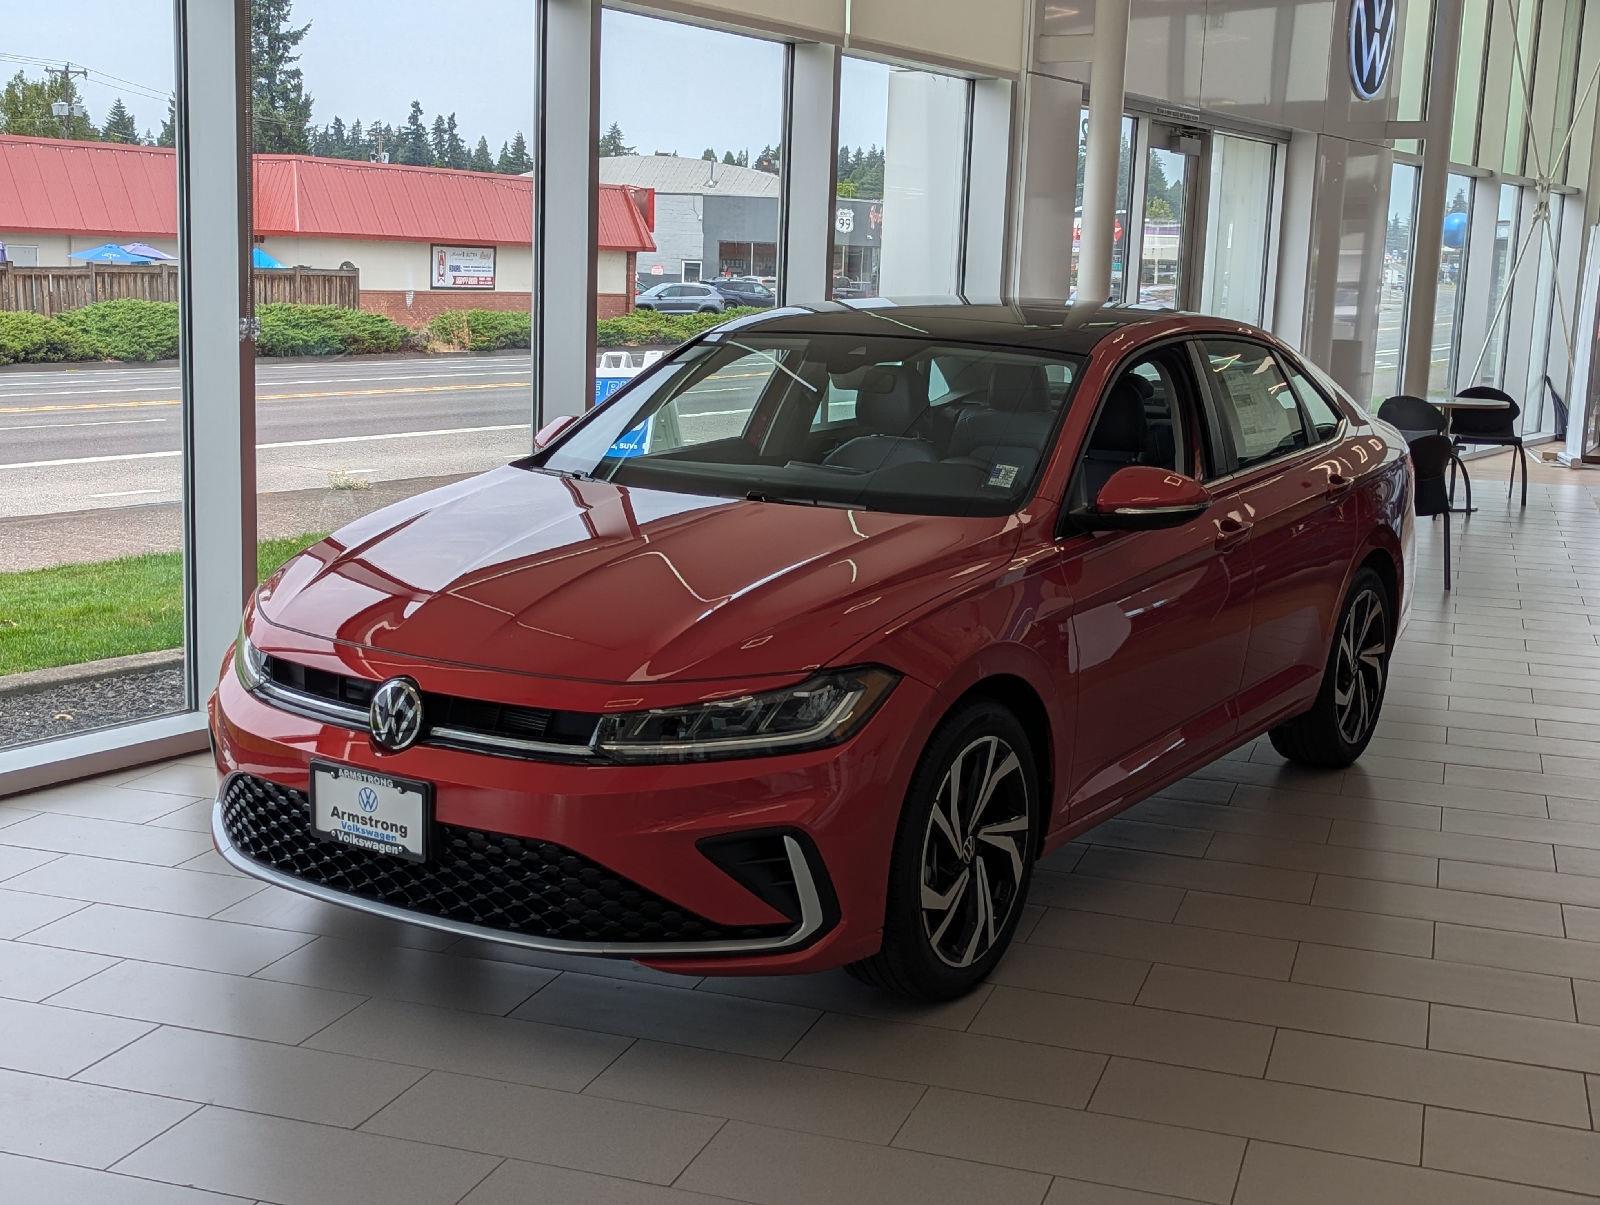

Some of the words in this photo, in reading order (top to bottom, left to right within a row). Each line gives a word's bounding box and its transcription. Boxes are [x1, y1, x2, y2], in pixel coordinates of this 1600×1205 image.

[838, 217, 851, 230] 99
[619, 442, 638, 450] SUVs
[338, 768, 394, 788] ARMSTRONG
[330, 806, 408, 838] Armstrong
[341, 820, 397, 842] Volkswagen
[336, 830, 399, 855] Volkswagen
